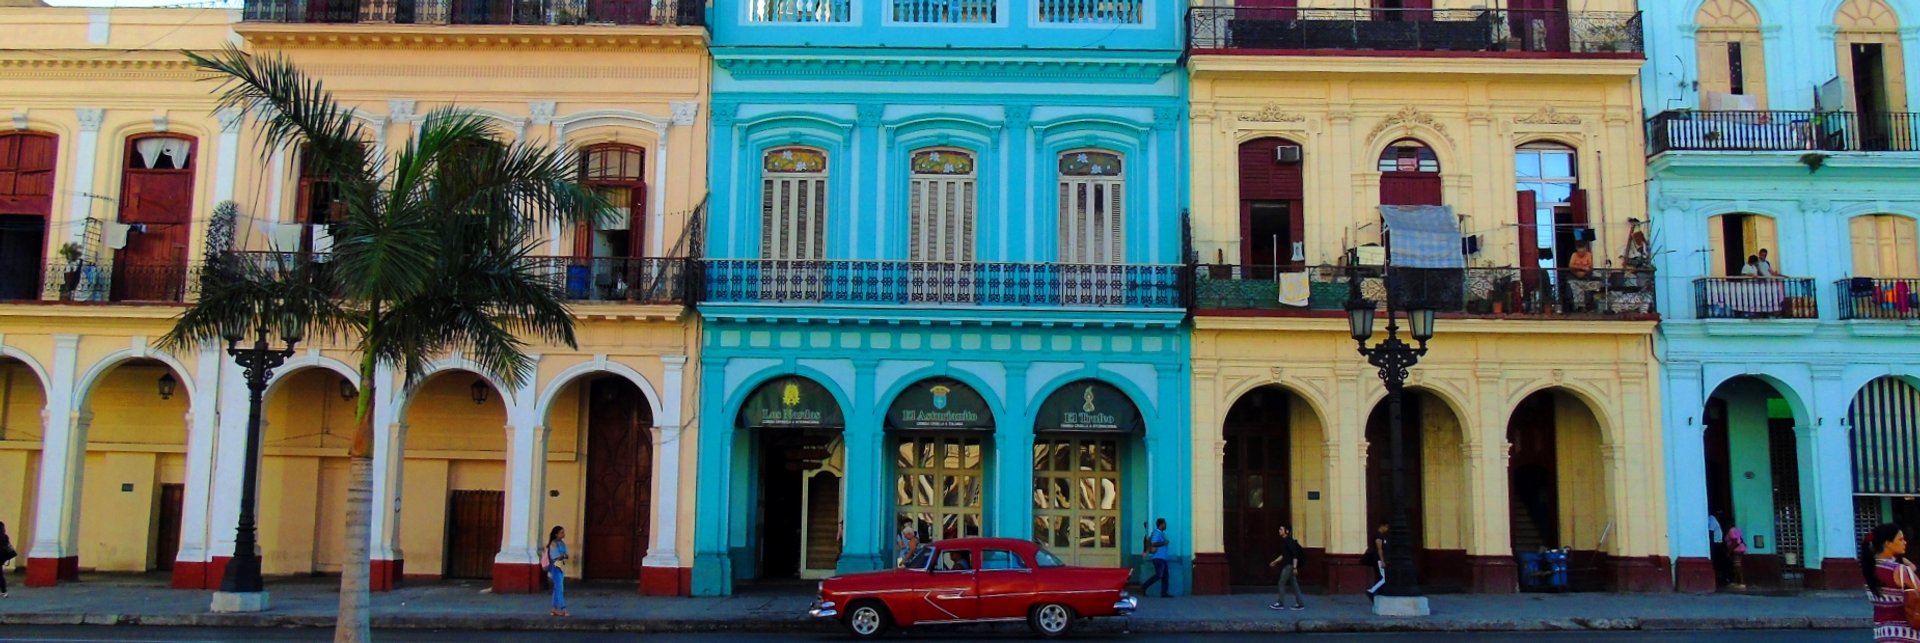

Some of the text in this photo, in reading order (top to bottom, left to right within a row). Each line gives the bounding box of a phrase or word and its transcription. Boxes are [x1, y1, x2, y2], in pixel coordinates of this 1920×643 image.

[762, 409, 821, 420] Los Nardos
[902, 410, 978, 421] El Asturianito
[1064, 412, 1078, 424] El
